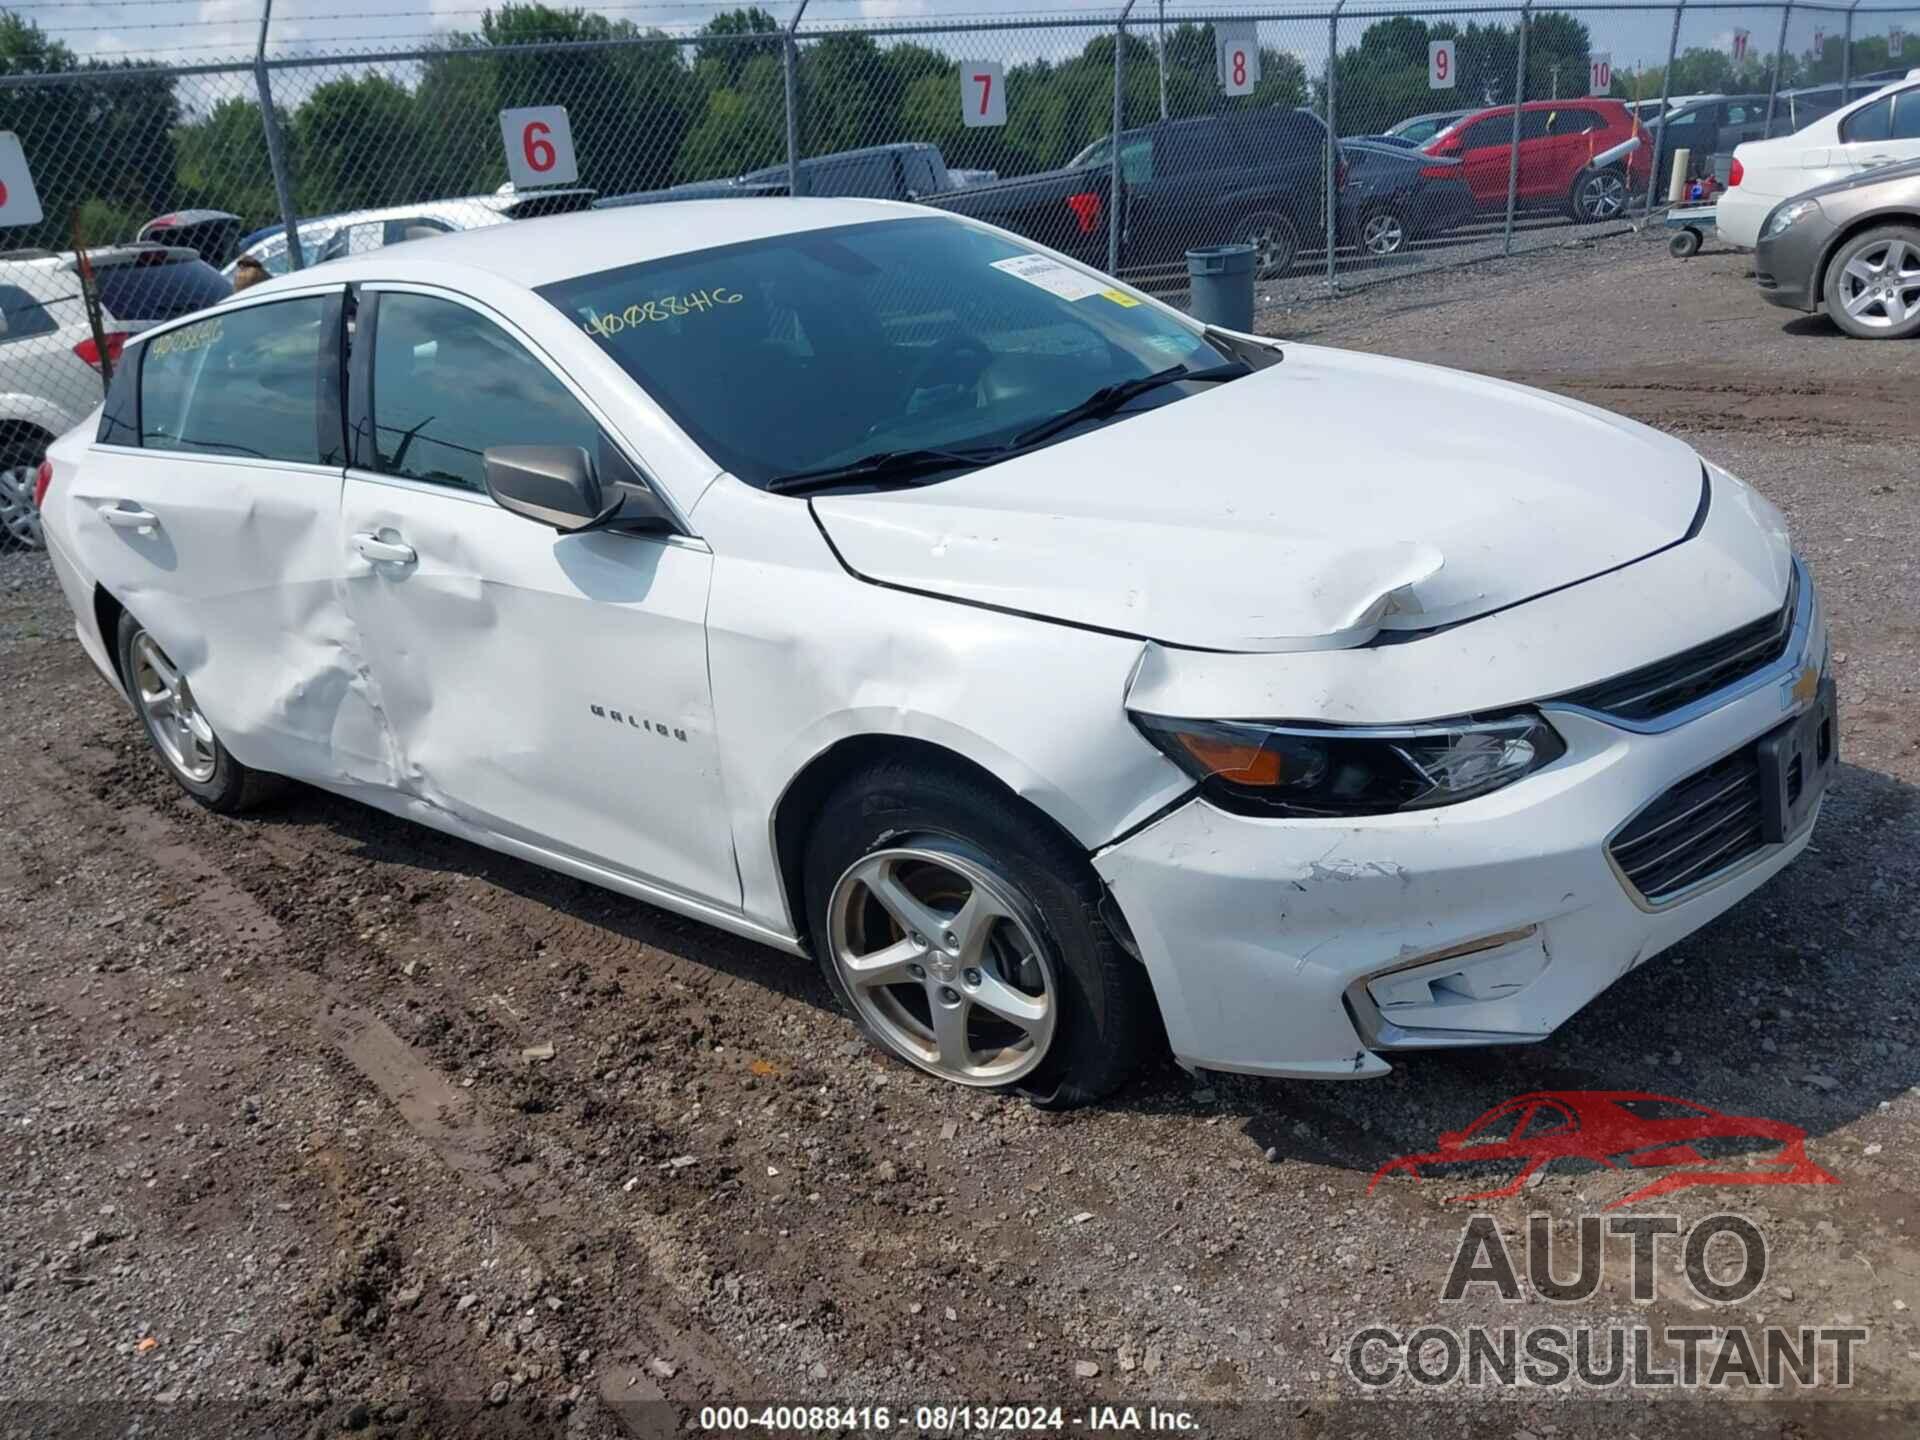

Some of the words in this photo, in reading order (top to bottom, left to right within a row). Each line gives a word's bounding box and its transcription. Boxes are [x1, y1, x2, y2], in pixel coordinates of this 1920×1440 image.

[1233, 50, 1247, 86] 8
[1436, 49, 1449, 81] 9
[1592, 62, 1610, 88] 10
[973, 75, 992, 115] 7
[523, 121, 557, 174] 6
[583, 287, 744, 339] 40088416
